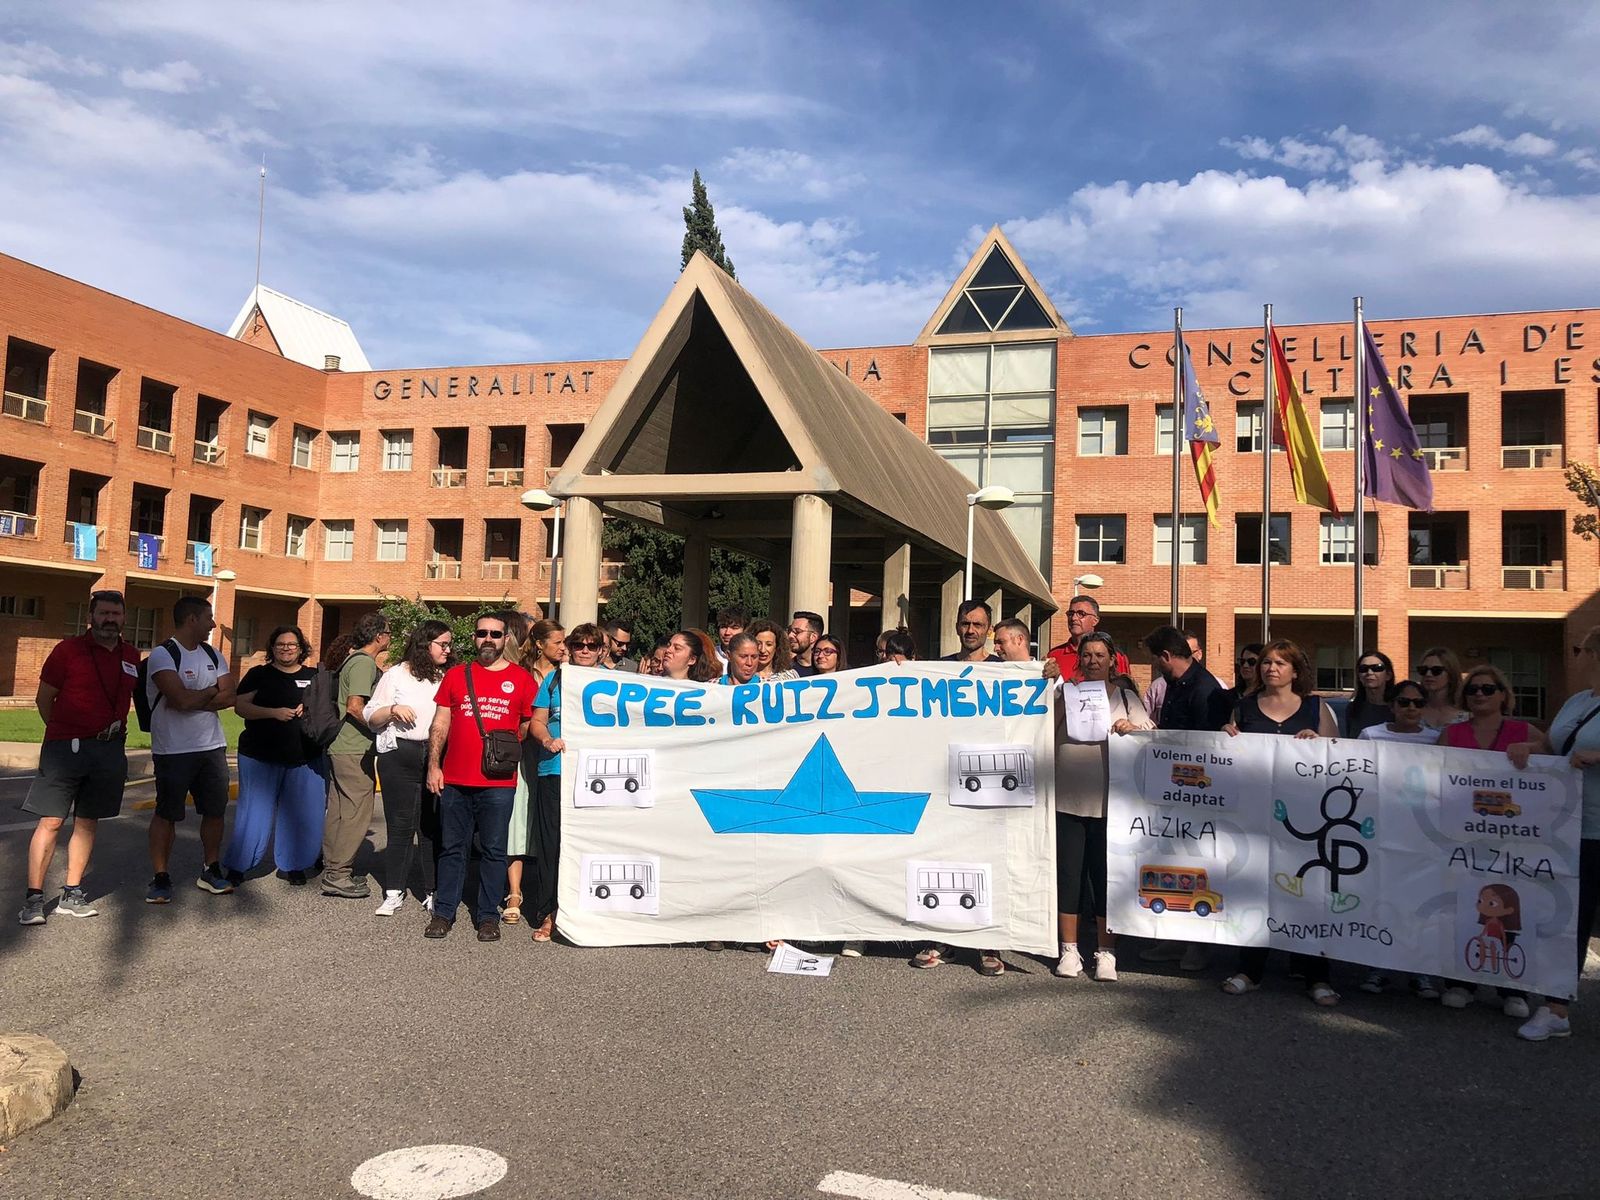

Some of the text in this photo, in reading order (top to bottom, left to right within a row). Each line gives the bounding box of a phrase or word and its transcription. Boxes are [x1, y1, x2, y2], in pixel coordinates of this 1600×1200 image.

[373, 371, 594, 400] GENERALITAT
[1228, 362, 1454, 396] CLTRA
[582, 666, 1049, 727] CPEE. RUIZ JIMÉNEZ
[480, 712, 502, 720] ualitat
[1152, 748, 1233, 766] Volem el bus
[1295, 758, 1378, 779] C.P.C.E.E.
[1448, 774, 1546, 791] Volem el bus
[1163, 789, 1225, 807] adaptat
[1129, 815, 1216, 841] ALZIRA
[1464, 820, 1541, 838] adaptat
[1448, 847, 1555, 880] ALZIRA
[1266, 917, 1393, 946] CARMEN PICÓ
